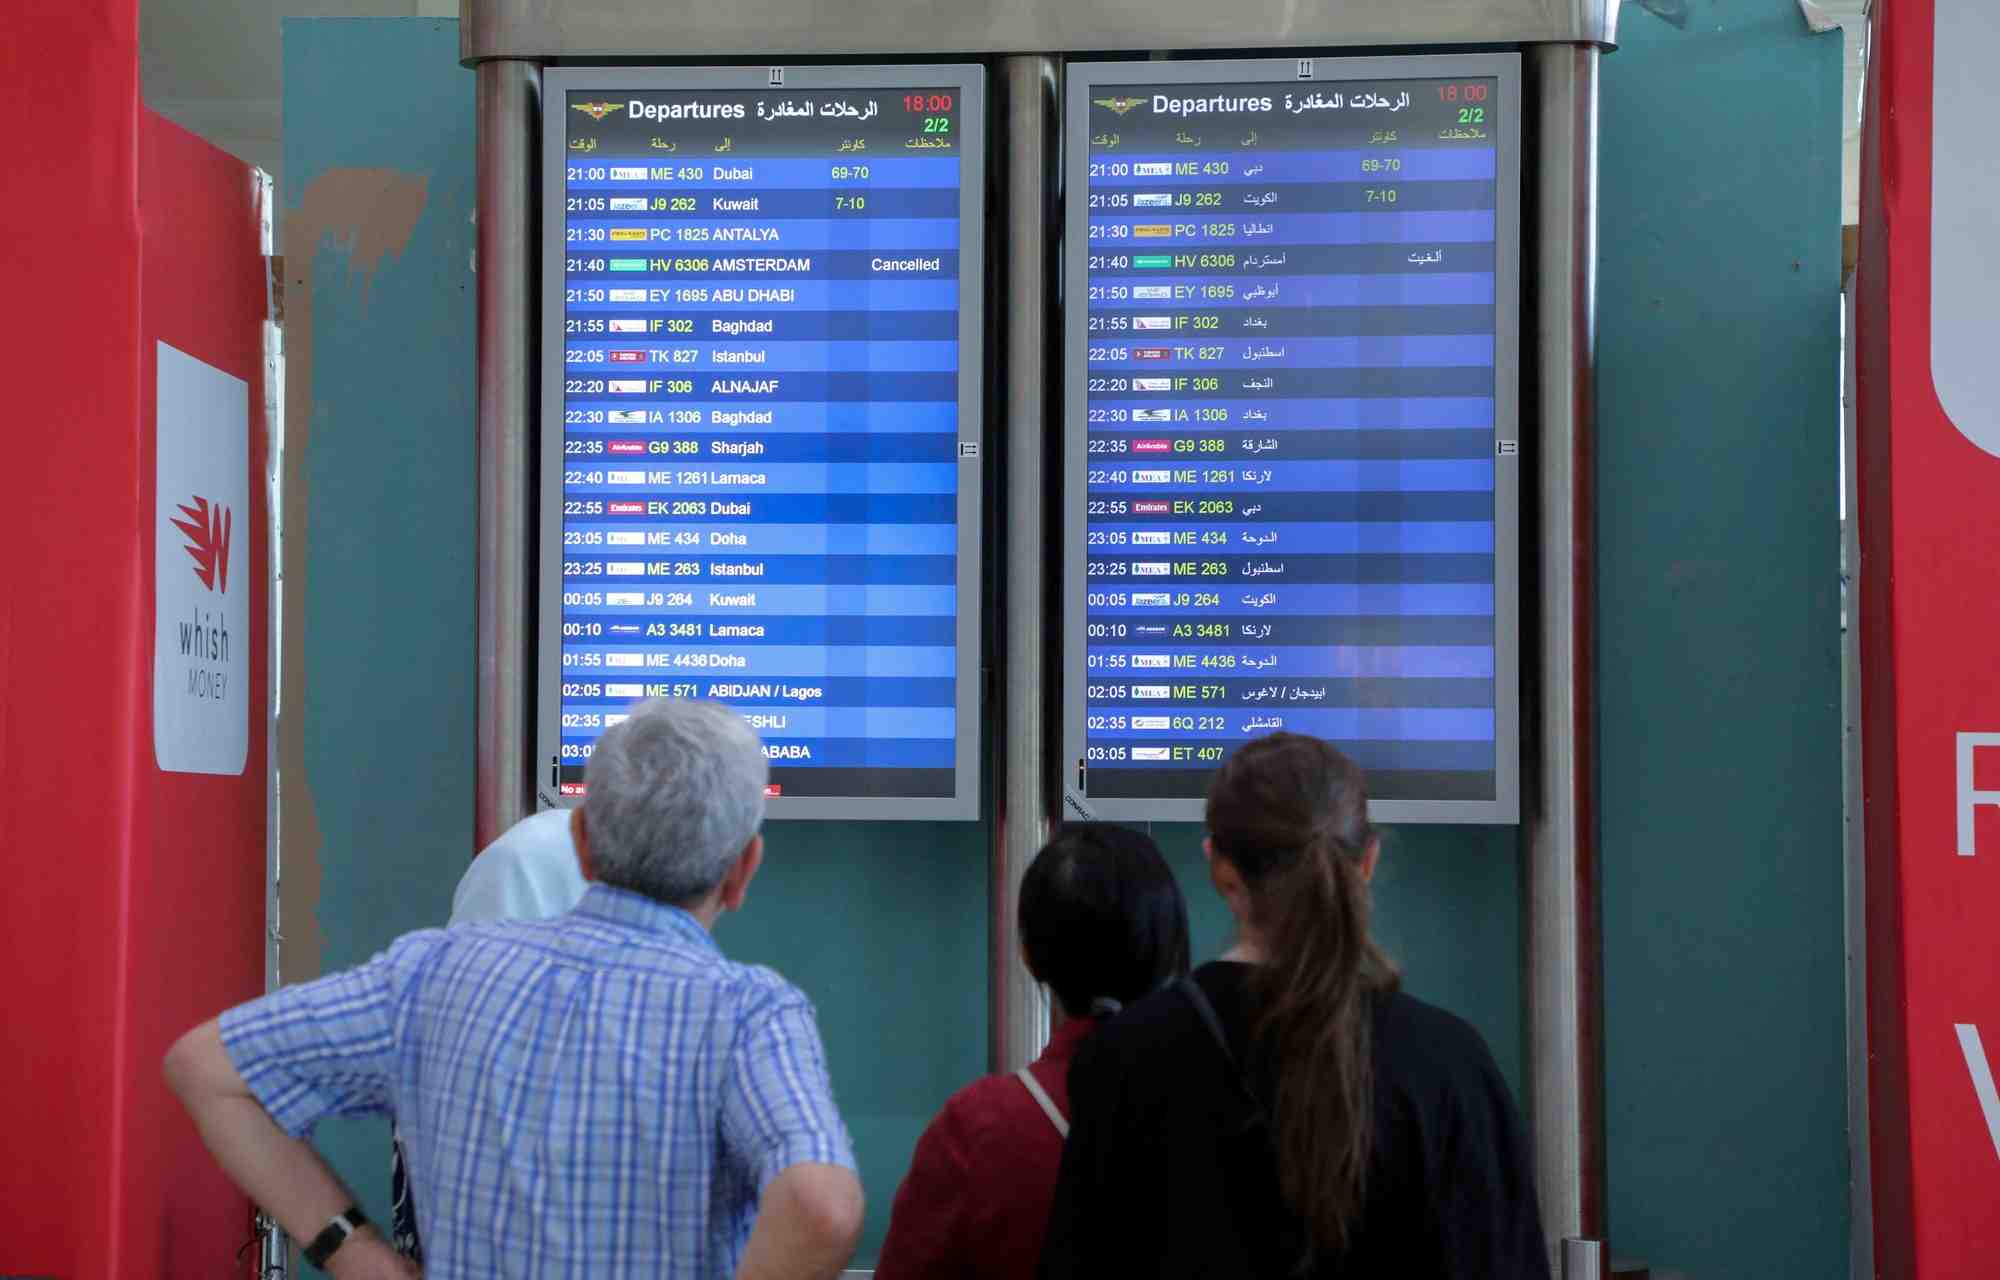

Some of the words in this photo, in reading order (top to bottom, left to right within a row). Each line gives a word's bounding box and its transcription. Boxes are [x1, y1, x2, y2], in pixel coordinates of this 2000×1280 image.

[903, 95, 952, 112] 18:00
[1152, 95, 1273, 117] Departures
[1284, 93, 1344, 114] المغادرة
[1350, 91, 1410, 112] الرحلات
[628, 100, 745, 123] Departures
[757, 100, 814, 121] المغادرة
[819, 100, 878, 120] الرحلات
[1457, 107, 1485, 123] 2/2
[923, 118, 949, 133] 2/2
[567, 167, 606, 181] 21:00
[650, 167, 674, 181] ME
[677, 167, 703, 181] 430
[713, 167, 753, 180] Dubai
[831, 166, 869, 180] 69-70
[1089, 163, 1129, 177] 21:00
[1175, 162, 1199, 176] ME
[1202, 161, 1229, 175] 430
[1361, 158, 1401, 172] 69-70
[566, 197, 605, 211] 21:05
[649, 197, 667, 211] J9
[670, 197, 696, 211] 262
[712, 197, 759, 211] Kuwait
[835, 197, 865, 210] 7-10
[1089, 193, 1129, 208] 21:05
[1174, 193, 1192, 207] J9
[1195, 192, 1222, 206] 262
[1366, 189, 1397, 203] 7-10
[566, 228, 605, 241] 21:30
[650, 228, 672, 241] PC
[677, 228, 710, 241] 1825
[711, 227, 780, 241] ANTALYA
[1089, 224, 1129, 239] 21:30
[1175, 223, 1196, 238] PC
[1201, 223, 1235, 237] 1825
[566, 258, 605, 272] 21:40
[649, 258, 672, 272] HV
[674, 258, 709, 272] 6306
[711, 258, 811, 272] AMSTERDAM
[871, 257, 940, 271] Cancelled
[1089, 255, 1129, 269] 21:40
[1174, 255, 1197, 268] HV
[1200, 254, 1235, 268] 6306
[566, 288, 605, 302] 21:50
[711, 288, 744, 303] ABU
[747, 288, 795, 302] DHABI
[1089, 286, 1128, 300] 21:50
[1174, 285, 1196, 299] EY
[1200, 285, 1234, 298] 1695
[566, 319, 605, 333] 21:55
[712, 319, 773, 336] Baghdad
[1089, 316, 1128, 330] 21:55
[1174, 316, 1189, 329] IF
[1193, 316, 1219, 329] 302
[566, 349, 604, 363] 22:05
[712, 349, 766, 363] Istanbul
[1089, 347, 1128, 361] 22:05
[1173, 346, 1195, 361] TK
[1198, 346, 1225, 361] 827
[565, 380, 604, 393] 22:20
[711, 380, 779, 394] ALNAJAF
[1088, 378, 1128, 392] 22:20
[1174, 377, 1188, 391] IF
[1192, 377, 1219, 391] 306
[565, 410, 604, 424] 22:30
[711, 410, 773, 427] Baghdad
[1089, 408, 1128, 422] 22:30
[1174, 408, 1189, 422] IA
[1194, 408, 1228, 422] 1306
[565, 440, 604, 454] 22:35
[711, 440, 764, 457] Sharjah
[1088, 439, 1128, 453] 22:35
[1173, 439, 1195, 453] G9
[1199, 439, 1225, 452] 388
[565, 471, 604, 485] 22:40
[1088, 470, 1127, 484] 22:40
[1173, 469, 1197, 483] ME
[1202, 470, 1234, 483] 1261
[564, 501, 603, 515] 22:55
[710, 501, 751, 516] Dubai
[1087, 500, 1128, 514] 22:55
[1173, 500, 1195, 514] EK
[1198, 500, 1234, 514] 2063
[564, 531, 603, 545] 23:05
[710, 531, 747, 546] Doha
[1087, 531, 1127, 545] 23:05
[1173, 531, 1197, 545] ME
[1201, 531, 1228, 545] 434
[564, 561, 602, 575] 23:25
[710, 562, 764, 576] Istanbul
[1087, 562, 1127, 576] 23:25
[1173, 562, 1197, 576] ME
[1200, 562, 1228, 576] 263
[563, 592, 602, 606] 00:05
[709, 592, 757, 607] Kuwait
[1087, 592, 1127, 607] 00:05
[1173, 593, 1190, 607] J9
[1193, 593, 1220, 607] 264
[179, 606, 229, 663] whish
[563, 622, 602, 636] 00:10
[1087, 623, 1127, 637] 00:10
[1172, 623, 1193, 637] A3
[1196, 624, 1229, 637] 3481
[562, 652, 602, 667] 01:55
[709, 653, 746, 668] Doha
[1087, 654, 1127, 668] 01:55
[1173, 654, 1197, 668] ME
[1201, 655, 1236, 668] 4436
[187, 667, 229, 701] MONEY
[562, 683, 601, 697] 02:05
[708, 684, 771, 698] ABIDJAN
[782, 684, 823, 701] Lagos
[1087, 685, 1127, 699] 02:05
[1173, 685, 1197, 699] ME
[1201, 685, 1225, 699] 571
[562, 713, 601, 728] 02:35
[1087, 716, 1127, 730] 02:35
[1172, 716, 1194, 730] 6Q
[1198, 716, 1225, 730] 212
[1087, 746, 1127, 761] 03:05
[1173, 746, 1194, 761] ET
[1197, 747, 1224, 761] 407
